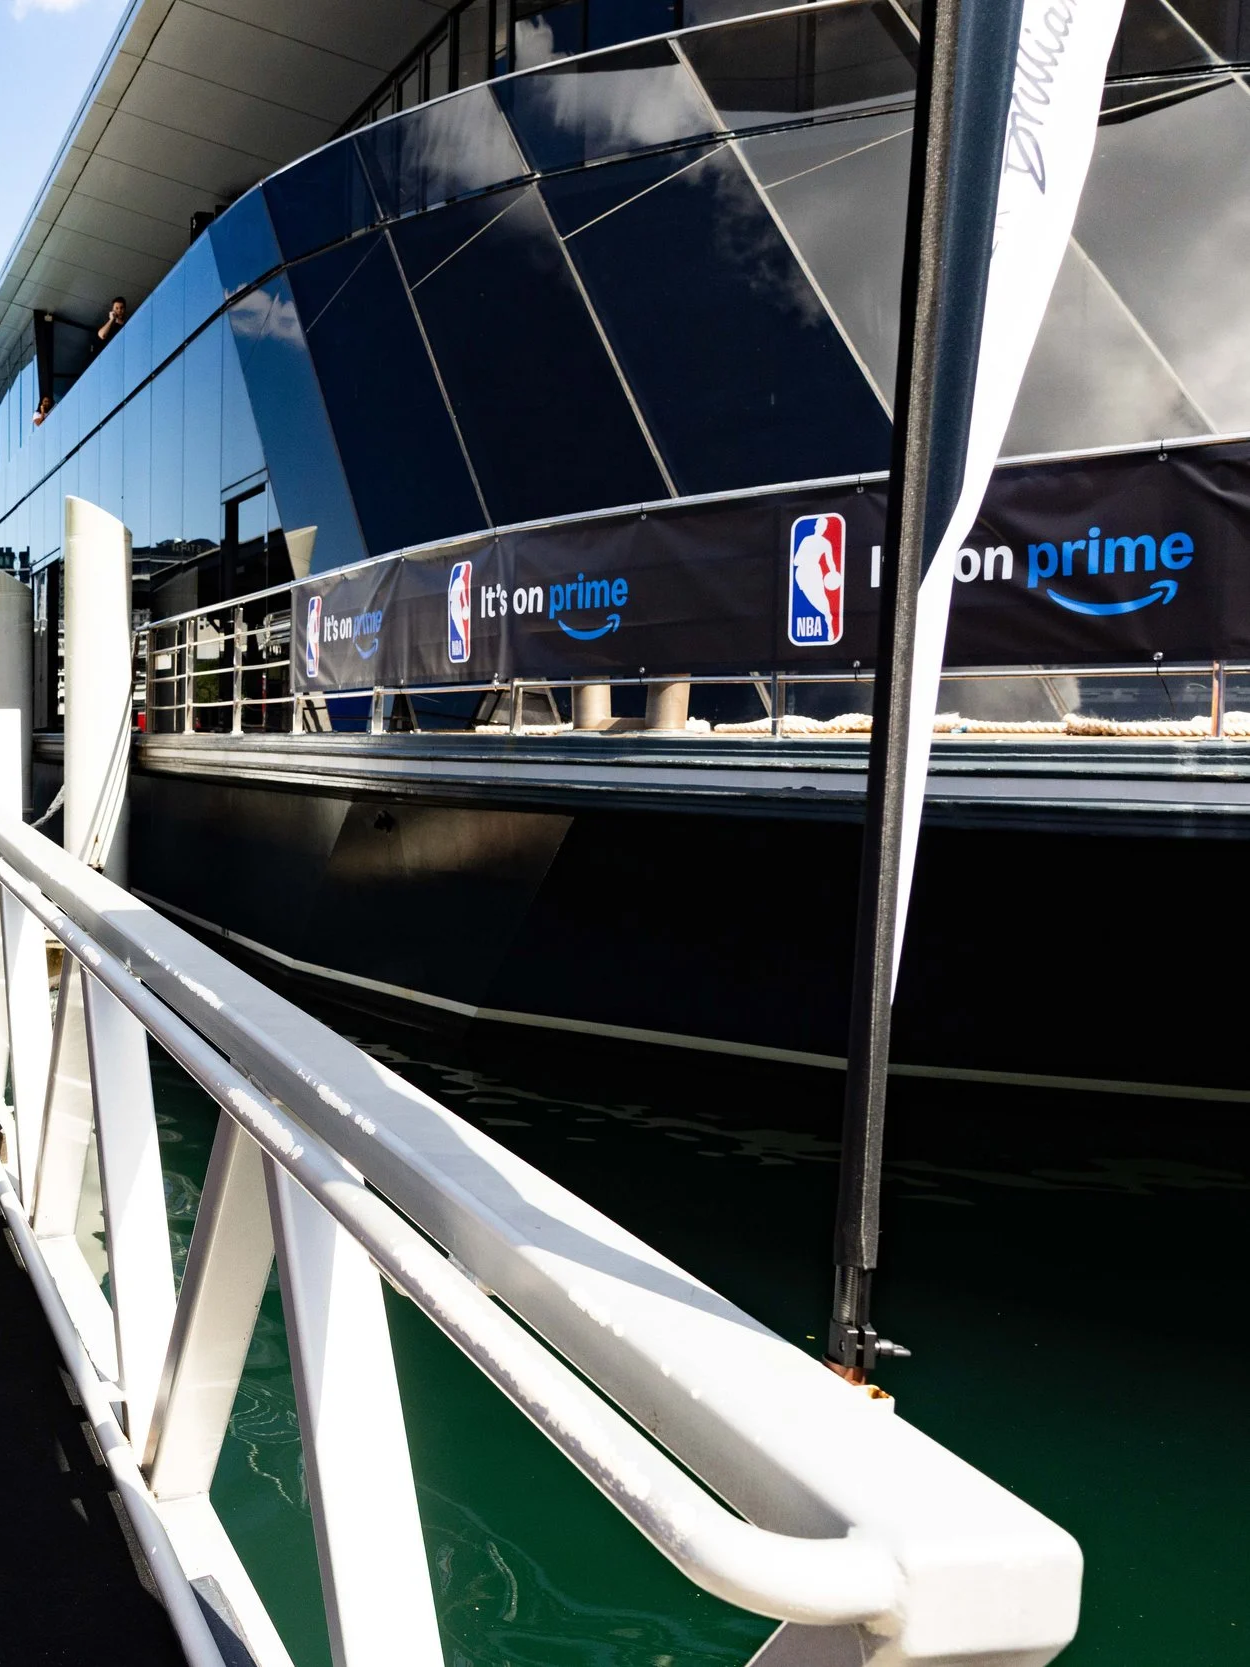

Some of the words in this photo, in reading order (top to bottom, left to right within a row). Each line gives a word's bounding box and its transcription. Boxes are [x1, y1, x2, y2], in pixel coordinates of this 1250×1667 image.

[954, 545, 1013, 584] on
[1027, 526, 1194, 589] prime
[480, 583, 508, 619] It's
[513, 584, 544, 615] on
[549, 573, 629, 620] prime
[323, 614, 338, 643] It's
[339, 616, 352, 640] on
[352, 606, 383, 643] prime
[796, 616, 823, 638] NBA
